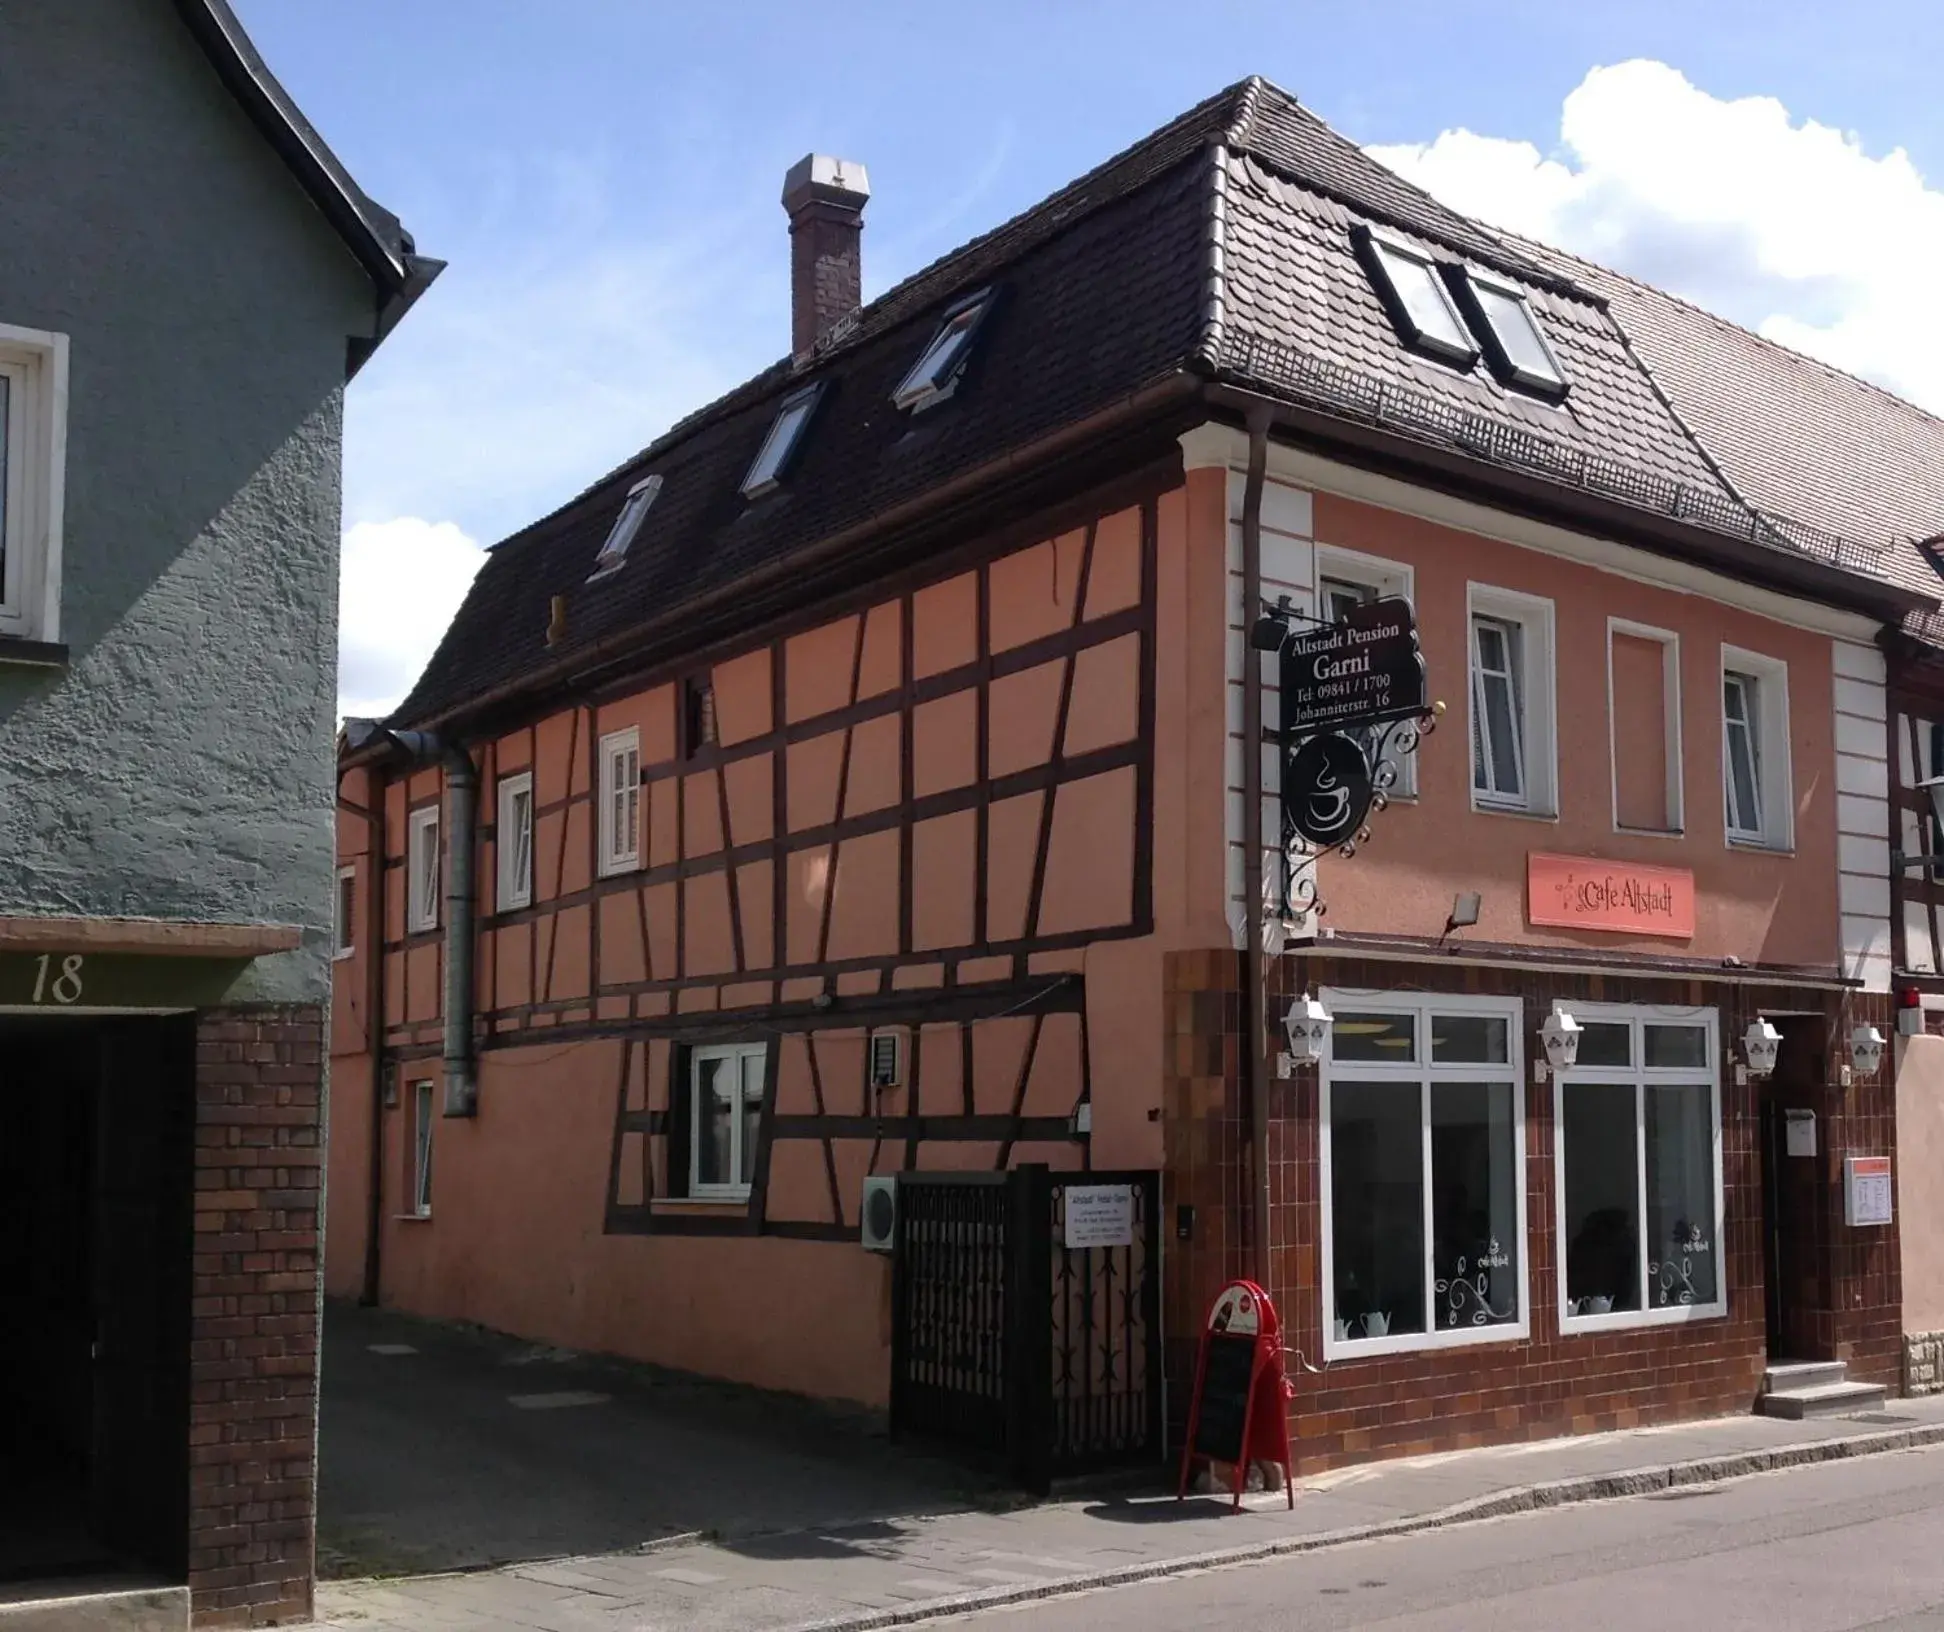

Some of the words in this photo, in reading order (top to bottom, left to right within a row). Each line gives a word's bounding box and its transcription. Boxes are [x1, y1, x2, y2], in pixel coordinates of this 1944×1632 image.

[1292, 631, 1343, 657] Altstadt
[1346, 622, 1400, 646] Pension
[1313, 648, 1370, 680] Garni
[1317, 681, 1350, 699] 09841
[1364, 673, 1391, 691] 1700
[1375, 691, 1390, 707] 16
[1578, 876, 1618, 912] Cafe
[1620, 877, 1673, 917] Altstadt
[32, 953, 83, 1003] 18
